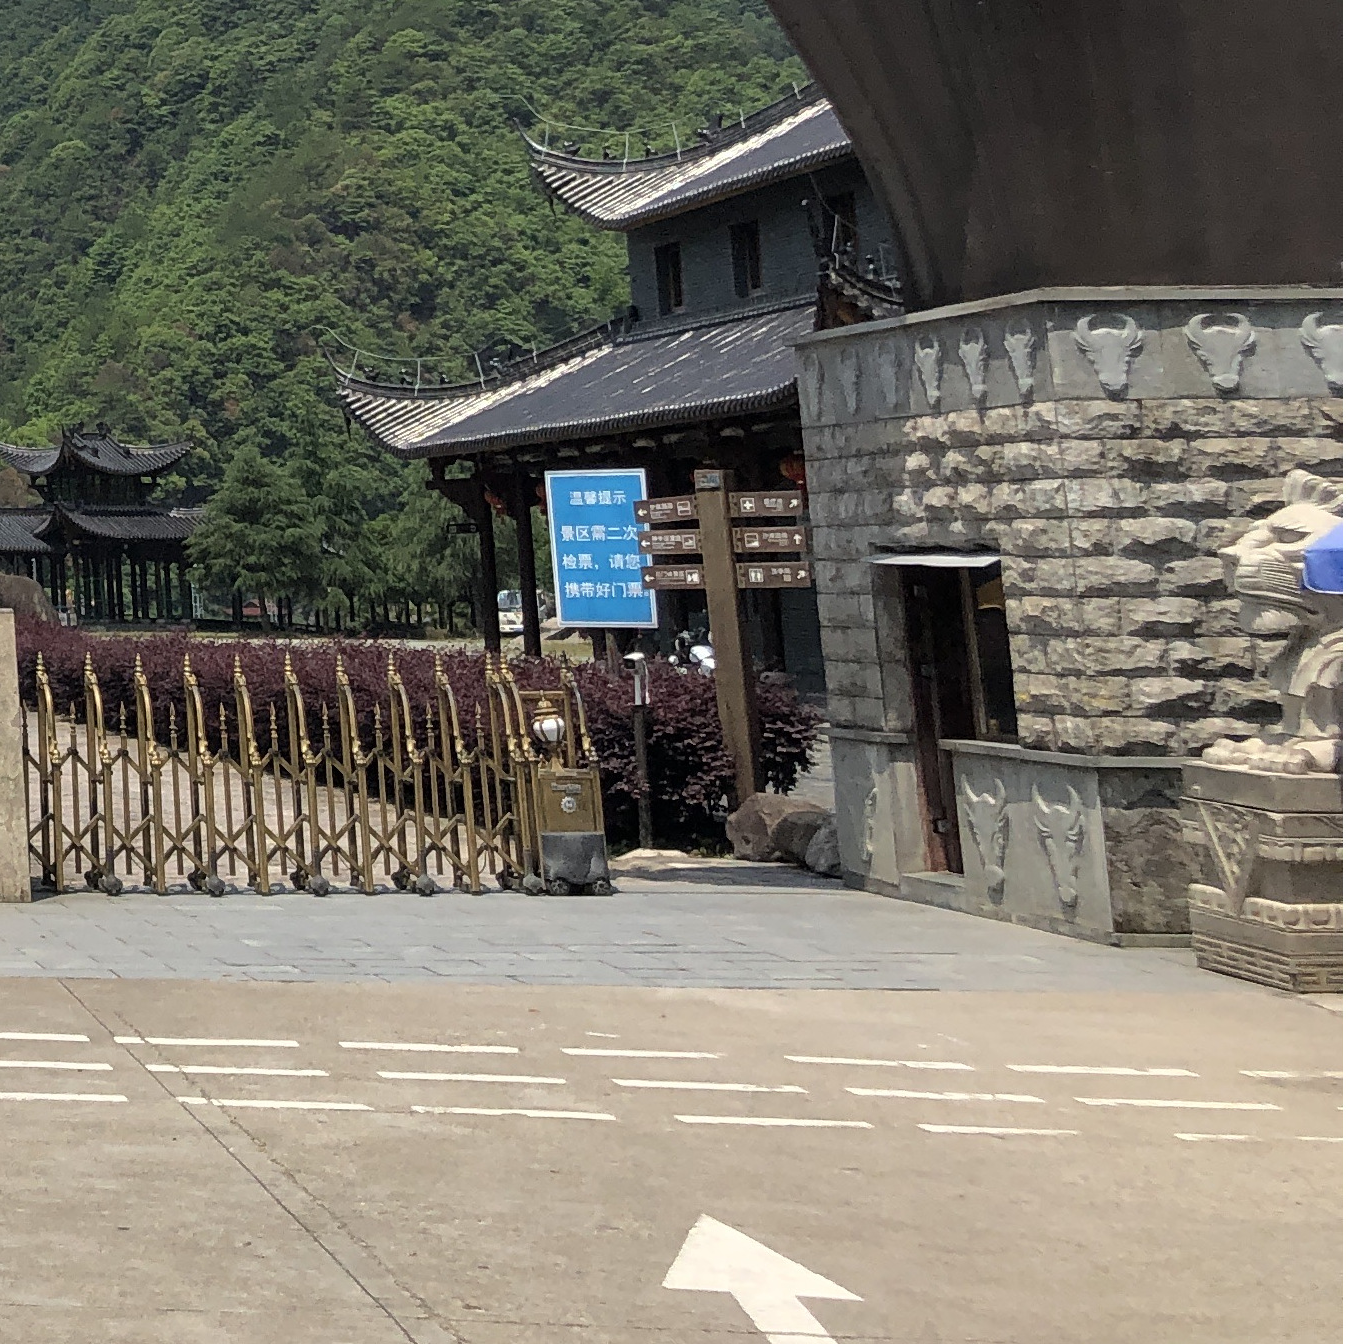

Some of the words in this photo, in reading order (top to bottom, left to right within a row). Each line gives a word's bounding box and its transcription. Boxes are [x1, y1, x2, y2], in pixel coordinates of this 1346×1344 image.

[569, 490, 626, 506] 温馨提示
[560, 525, 638, 542] 景区需二次
